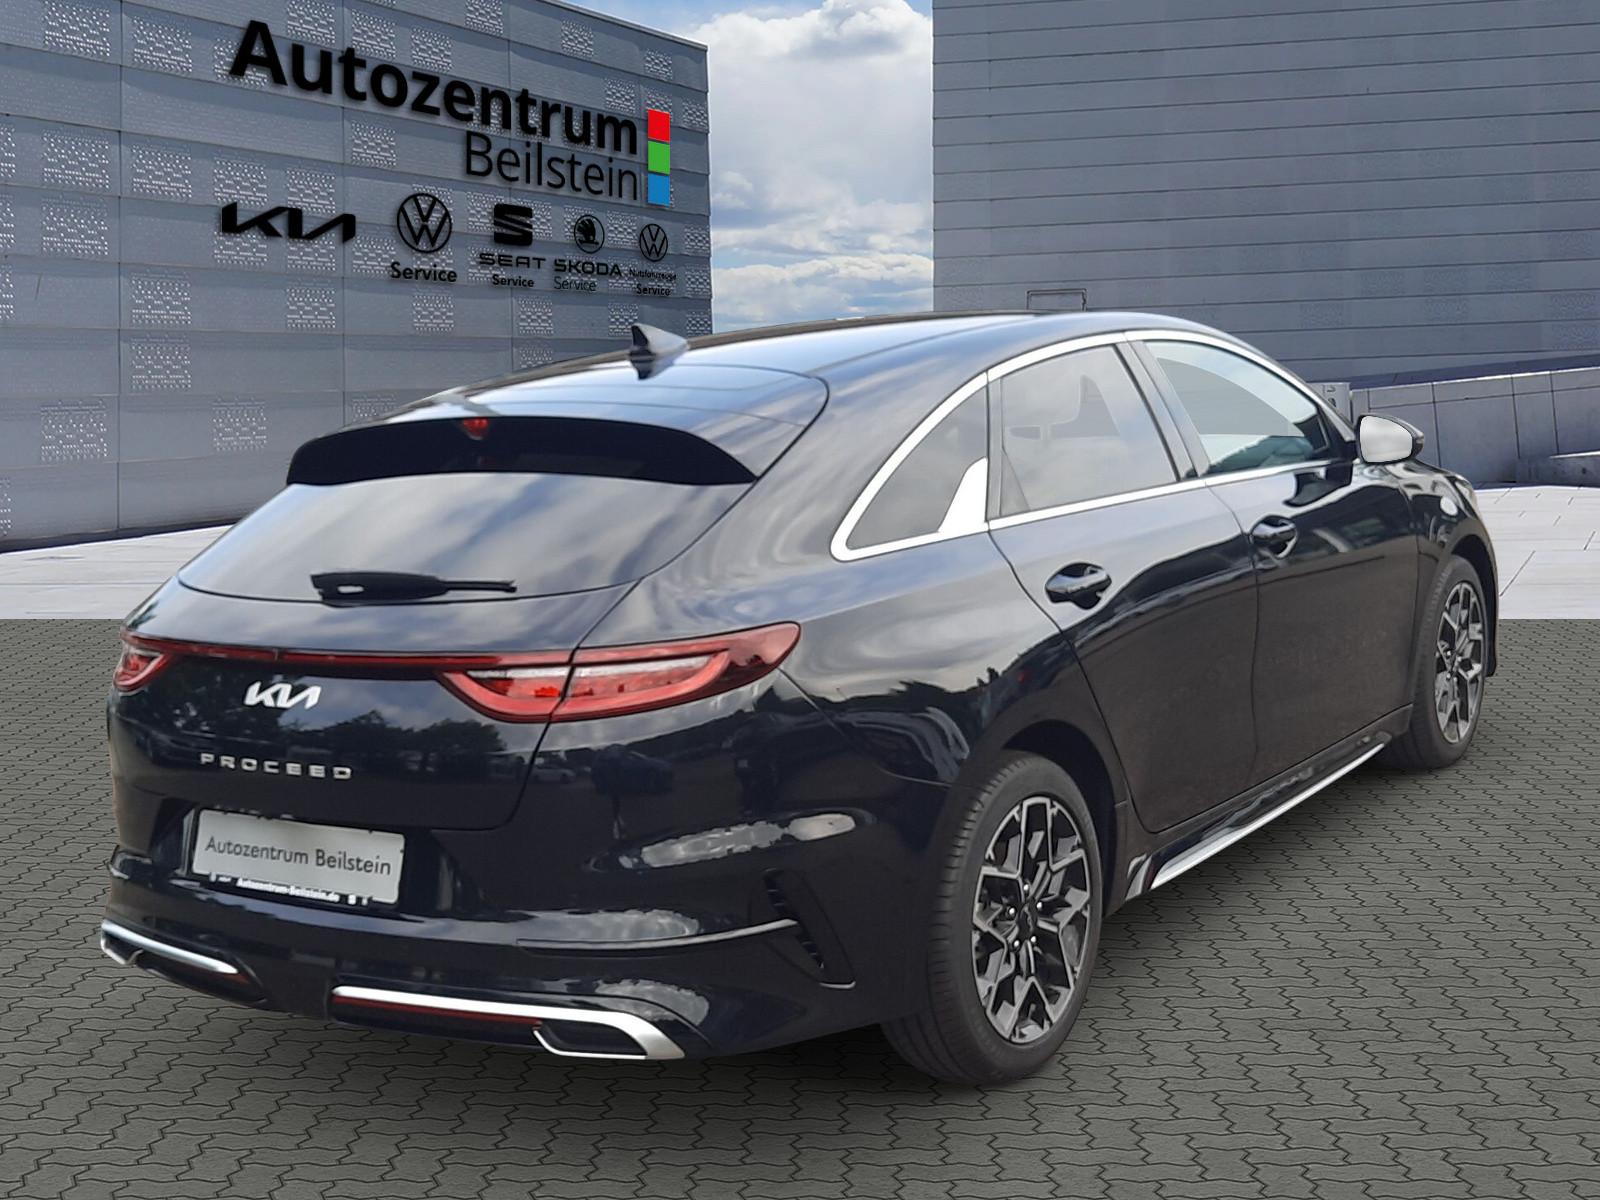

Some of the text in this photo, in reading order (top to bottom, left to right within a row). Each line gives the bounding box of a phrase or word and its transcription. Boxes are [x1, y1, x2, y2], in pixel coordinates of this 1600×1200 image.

[228, 19, 639, 155] Autozentrum
[465, 130, 639, 201] Beilstein
[390, 261, 458, 283] Service
[479, 252, 547, 270] SEAT
[492, 273, 536, 288] Service
[553, 276, 597, 292] Service
[636, 283, 671, 297] Service
[200, 753, 353, 780] PROCEED
[205, 836, 392, 876] Autozentrum Beilstein
